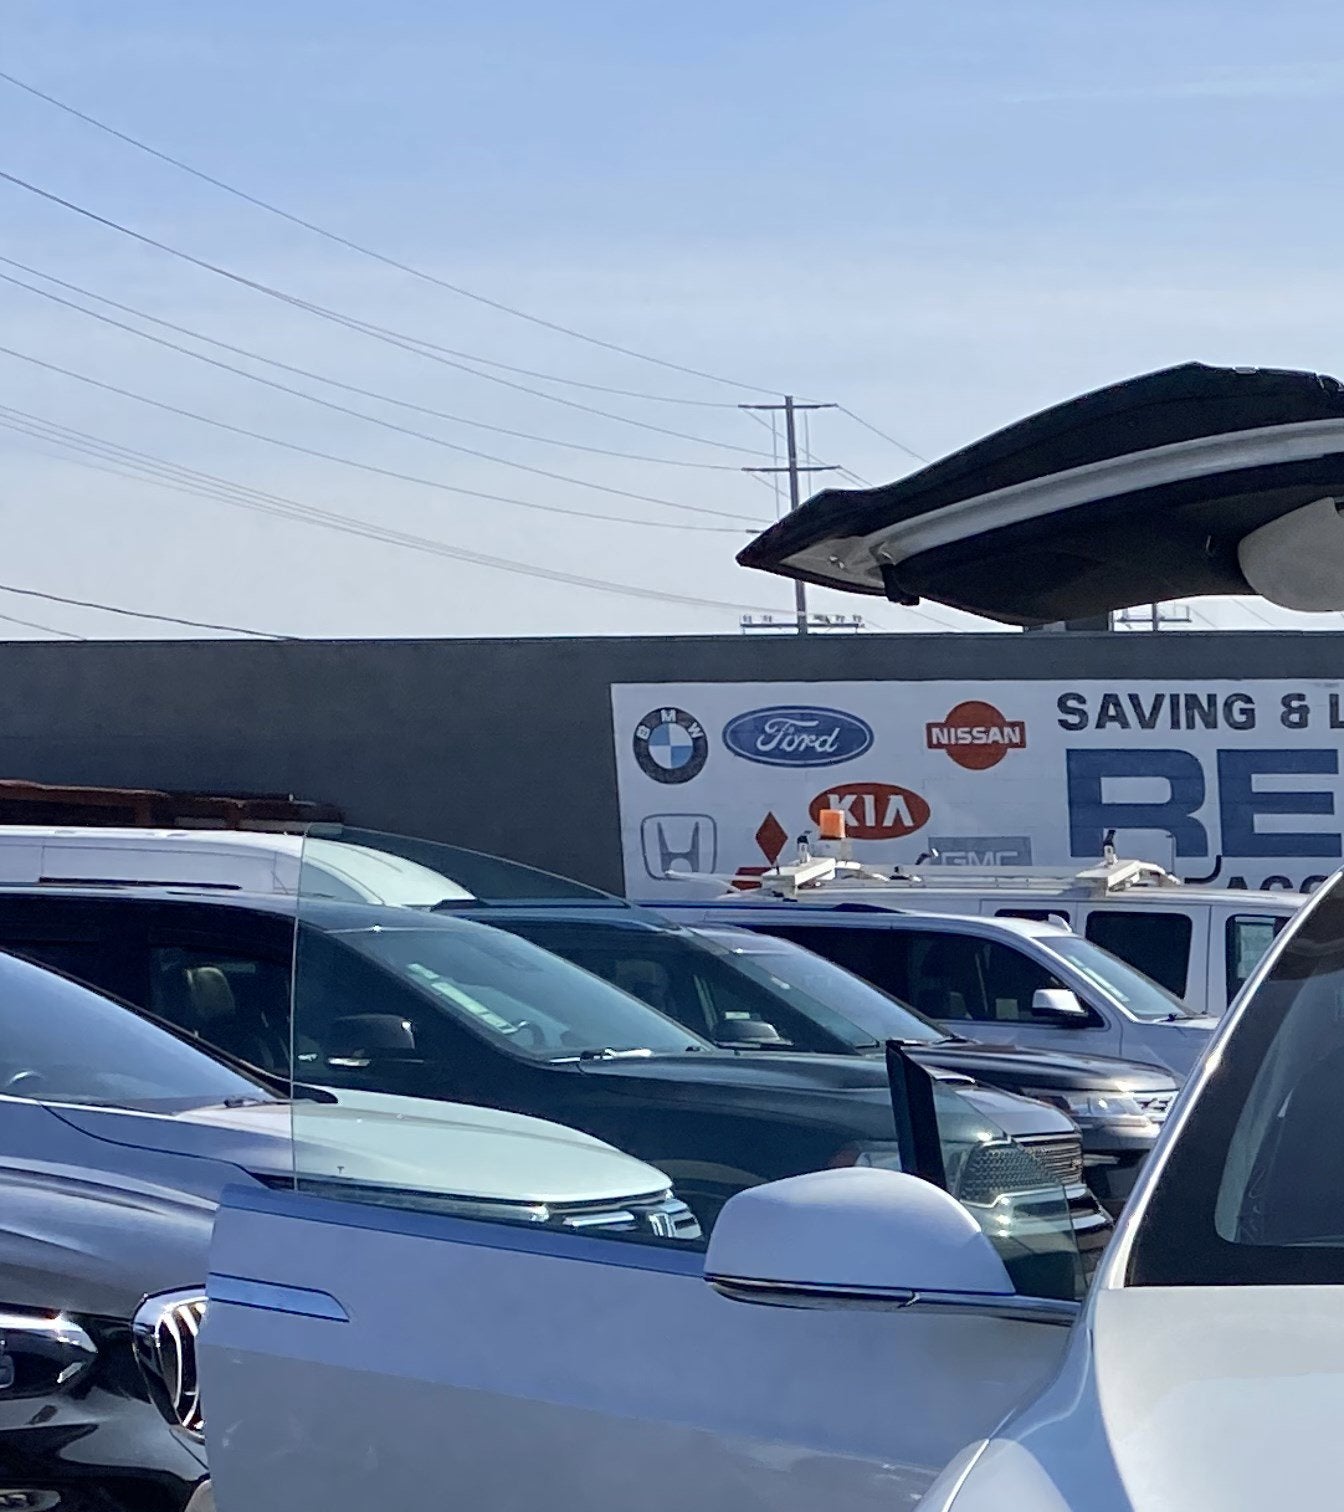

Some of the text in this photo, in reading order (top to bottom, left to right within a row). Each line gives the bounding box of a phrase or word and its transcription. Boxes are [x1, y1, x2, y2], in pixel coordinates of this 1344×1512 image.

[1057, 692, 1256, 731] SAVING
[1279, 693, 1311, 730] &
[756, 717, 861, 752] Ford
[931, 726, 1022, 745] NISSAN
[826, 794, 915, 828] KIA
